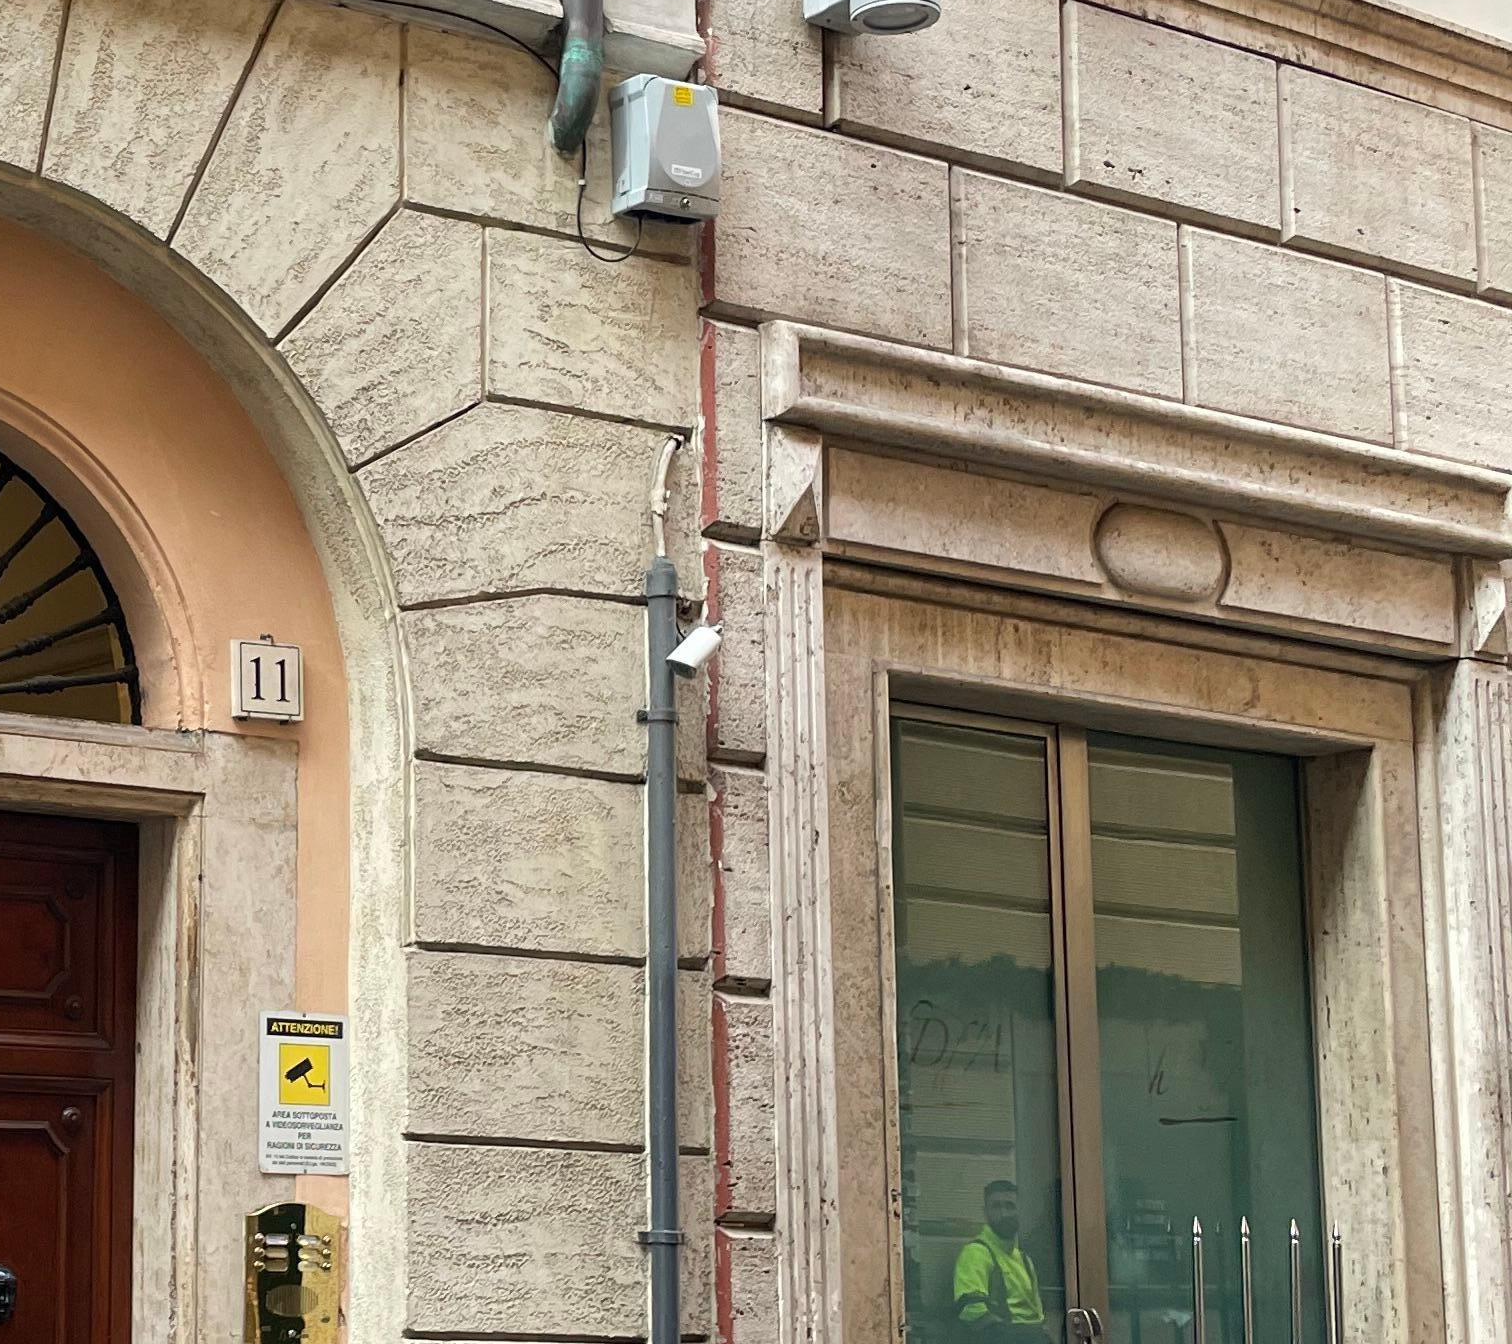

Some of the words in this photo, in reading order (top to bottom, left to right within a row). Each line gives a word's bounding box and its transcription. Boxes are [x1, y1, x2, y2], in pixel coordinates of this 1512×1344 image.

[249, 656, 291, 703] 11
[270, 1021, 339, 1036] ATTENZIONE!
[272, 1110, 291, 1119] AREA
[292, 1111, 337, 1120] SOTTOPOSTA
[265, 1120, 271, 1128] A
[297, 1131, 312, 1140] PER
[304, 1142, 342, 1151] SICUREZZA
